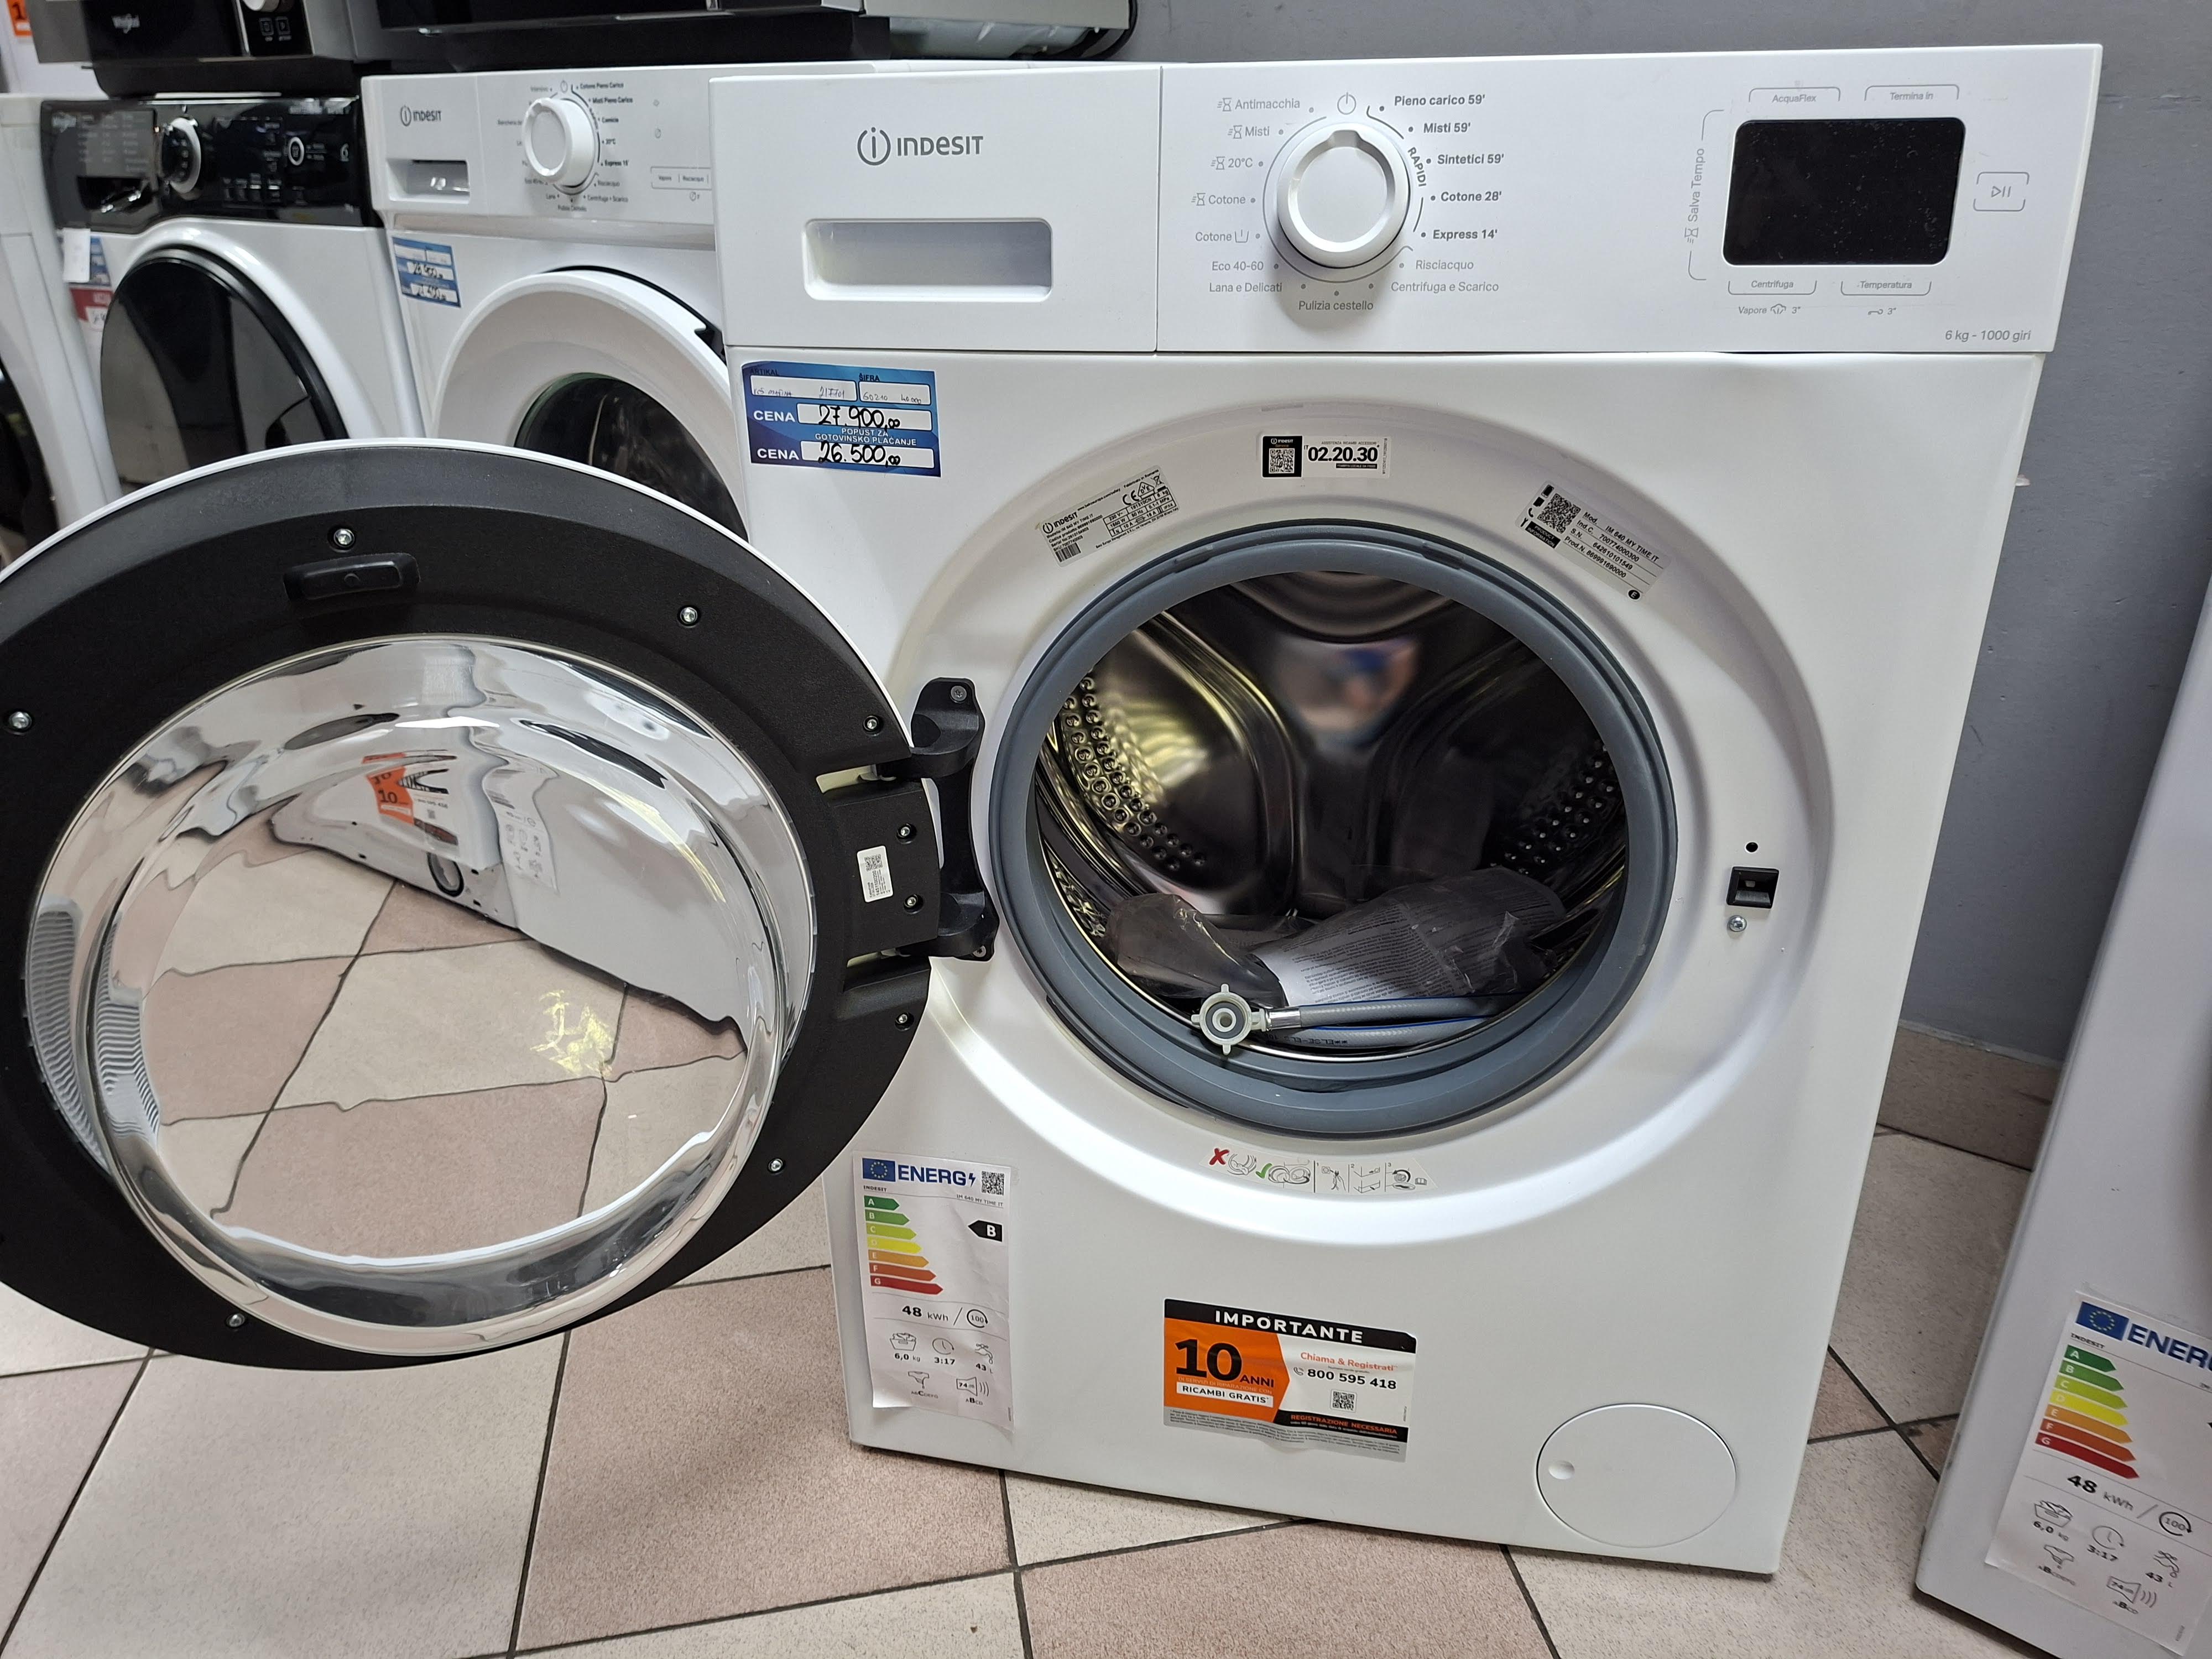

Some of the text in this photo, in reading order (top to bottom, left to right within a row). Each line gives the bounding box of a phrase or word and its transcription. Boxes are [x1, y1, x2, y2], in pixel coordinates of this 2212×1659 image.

[1394, 94, 1486, 106] Pieno carico 59'
[1772, 93, 1817, 105] AcquaFlex
[1890, 91, 1934, 101] Termina in
[1235, 97, 1300, 110] Antimacchia
[1245, 126, 1270, 137] Misti
[1423, 122, 1471, 134] Misti 59'
[1228, 157, 1253, 168] 20°C
[1437, 153, 1504, 164] Sintetici 59'
[1407, 146, 1427, 187] RAPIDI
[1688, 148, 1705, 222] Salva Tempo
[1208, 194, 1246, 205] Cotone
[1441, 191, 1502, 202] Cotone 28'
[1195, 231, 1232, 241] Cotone
[1432, 229, 1498, 241] Express 14'
[1212, 260, 1264, 271] Eco 40-60
[1415, 260, 1474, 272] Risciacquo
[1209, 281, 1282, 293] Lana e Delicati
[1391, 281, 1447, 294] Centrifuga
[1458, 281, 1499, 292] Scarico
[1751, 279, 1794, 290] Centrifuga
[1860, 281, 1912, 291] Temperatura
[1298, 300, 1374, 311] Pulizia cestello
[1738, 306, 1767, 316] Vapore
[1945, 330, 1953, 342] 6
[1955, 330, 1970, 343] kg
[1980, 331, 2010, 342] 1000
[2012, 330, 2031, 343] giri
[859, 373, 880, 381] ŠIFRA
[754, 410, 795, 422] CENA
[842, 428, 875, 436] POPUST
[815, 433, 917, 446] GOTOVINSKO PLAĆANJE
[757, 448, 799, 460] CENA
[1053, 512, 1078, 528] INDESIT
[1534, 525, 1553, 540] PRODUCT
[1577, 520, 1594, 534] Ind.C.
[1527, 527, 1554, 547] INFORMATION
[1571, 528, 1583, 539] S.N.
[1584, 512, 1598, 524] Mod.
[1606, 525, 1613, 534] IM
[1614, 531, 1624, 541] 640
[1625, 538, 1635, 548] MY
[1636, 545, 1651, 557] TIME
[1564, 536, 1585, 552] Prod.N.
[898, 1164, 966, 1186] ENERG
[987, 1224, 996, 1237] B
[902, 1306, 922, 1317] 48
[927, 1312, 949, 1322] kWh
[1215, 1310, 1364, 1344] IMPORTANTE
[2127, 1323, 2212, 1372] ENER
[1301, 1352, 1335, 1364] Chiama
[2070, 1350, 2079, 1359] A
[934, 1357, 956, 1365] 3:17
[975, 1363, 987, 1371] 43
[1175, 1338, 1275, 1388] 10 ANNI
[2065, 1365, 2074, 1374] B
[1307, 1369, 1334, 1380] 800
[1339, 1373, 1365, 1385] 595
[1370, 1378, 1396, 1389] 418
[2060, 1380, 2068, 1389] C
[1183, 1386, 1225, 1397] RICAMBI
[966, 1397, 983, 1406] ABCD
[2051, 1409, 2058, 1417] E
[1291, 1415, 1349, 1427] REGISTRAZIONE
[1352, 1422, 1397, 1434] NECESSARIA
[2041, 1437, 2051, 1446] G
[2067, 1475, 2186, 1531] 48 kWh 100
[2086, 1545, 2119, 1562] 3:17
[2145, 1572, 2163, 1583] 43
